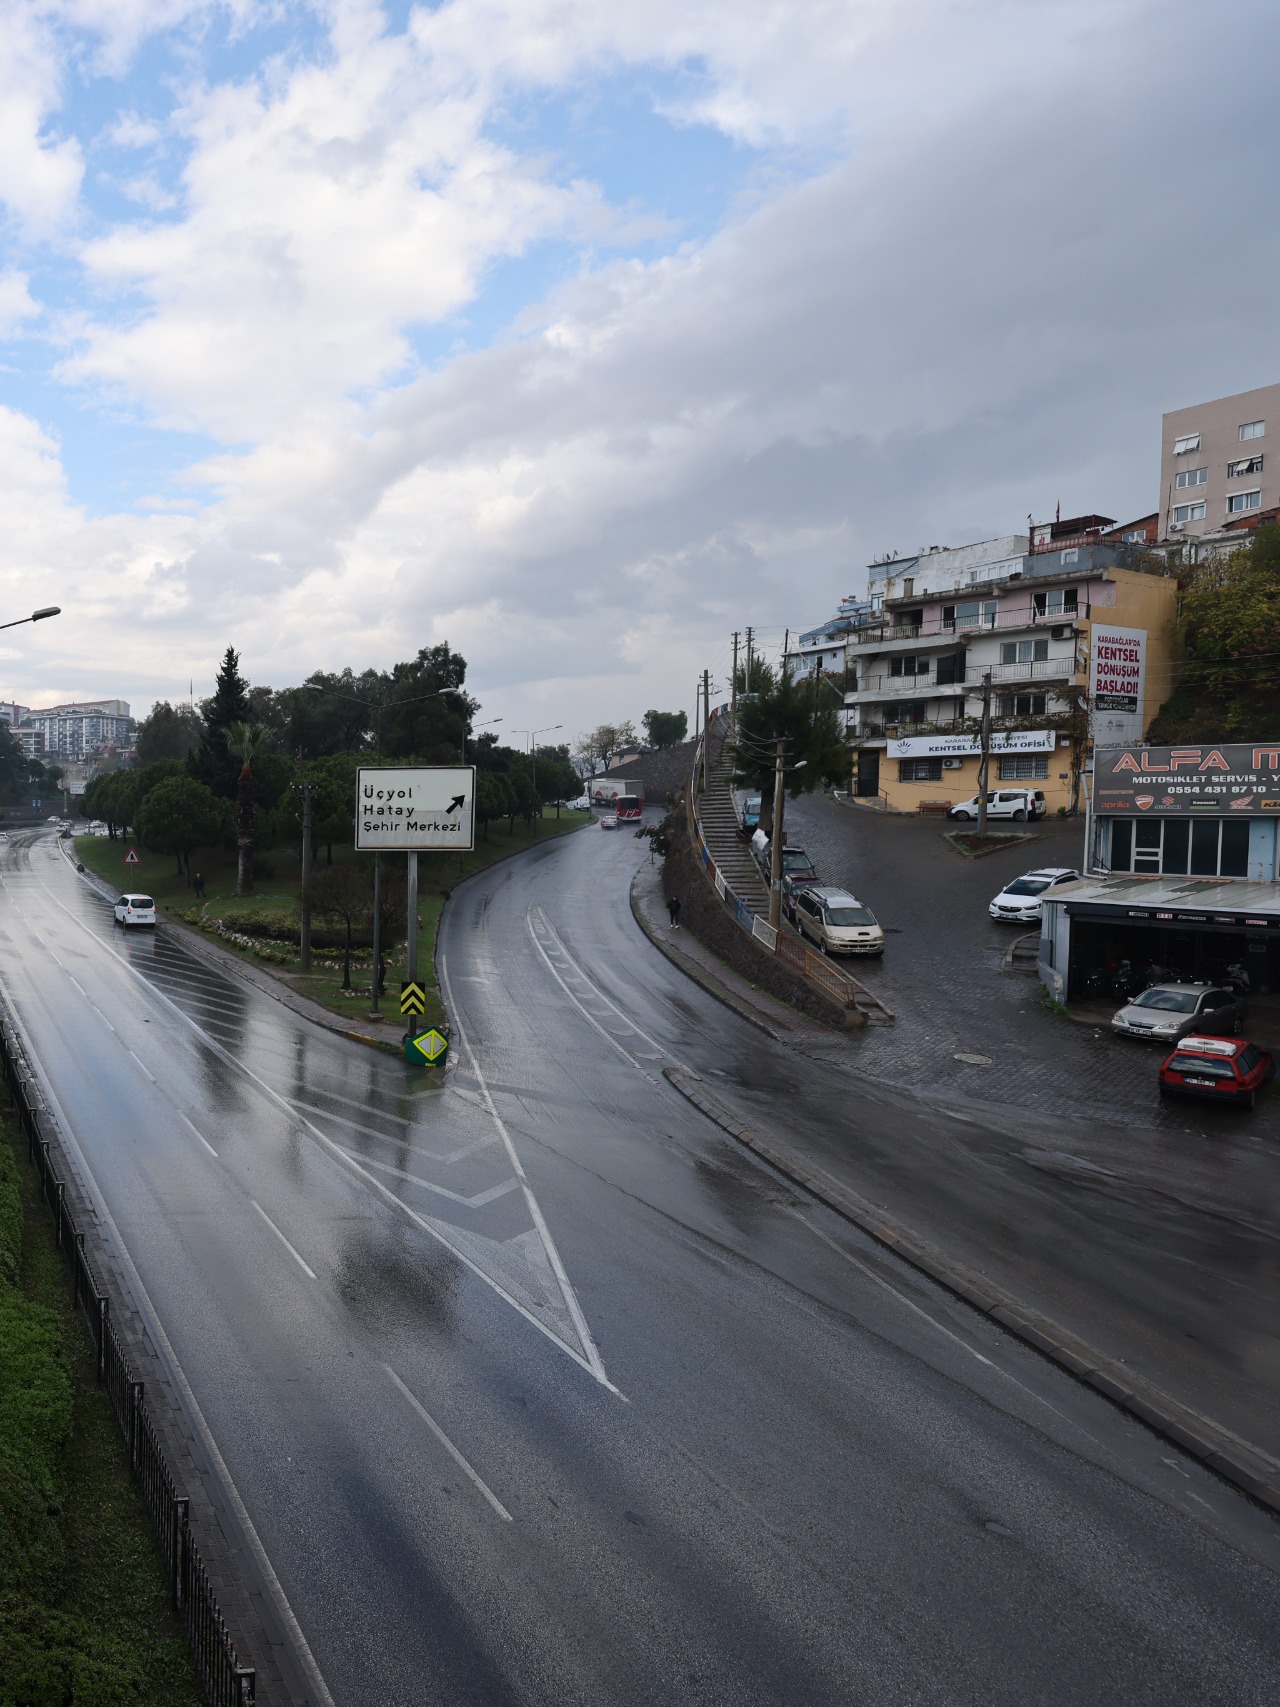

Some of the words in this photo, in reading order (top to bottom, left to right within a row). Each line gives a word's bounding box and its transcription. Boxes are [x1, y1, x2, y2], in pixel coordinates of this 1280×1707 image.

[1097, 635, 1141, 647] KARABAĞLAR'DA
[1097, 645, 1140, 663] KENTSEL
[1097, 662, 1140, 678] DÖNÜŞÜM
[1096, 678, 1139, 695] BAŞLADI!
[928, 744, 967, 752] KENTSEL
[970, 741, 1018, 750] DÖÜŞÜM
[1020, 739, 1045, 748] OFİSİ
[1112, 750, 1230, 773] ALFA
[364, 785, 412, 801] Üçyol
[1167, 786, 1200, 794] 0554
[1204, 786, 1226, 794] 431
[1251, 785, 1266, 793] 10
[363, 804, 415, 818] Hatay
[363, 821, 400, 832] Şehir
[406, 821, 461, 832] Merkezi
